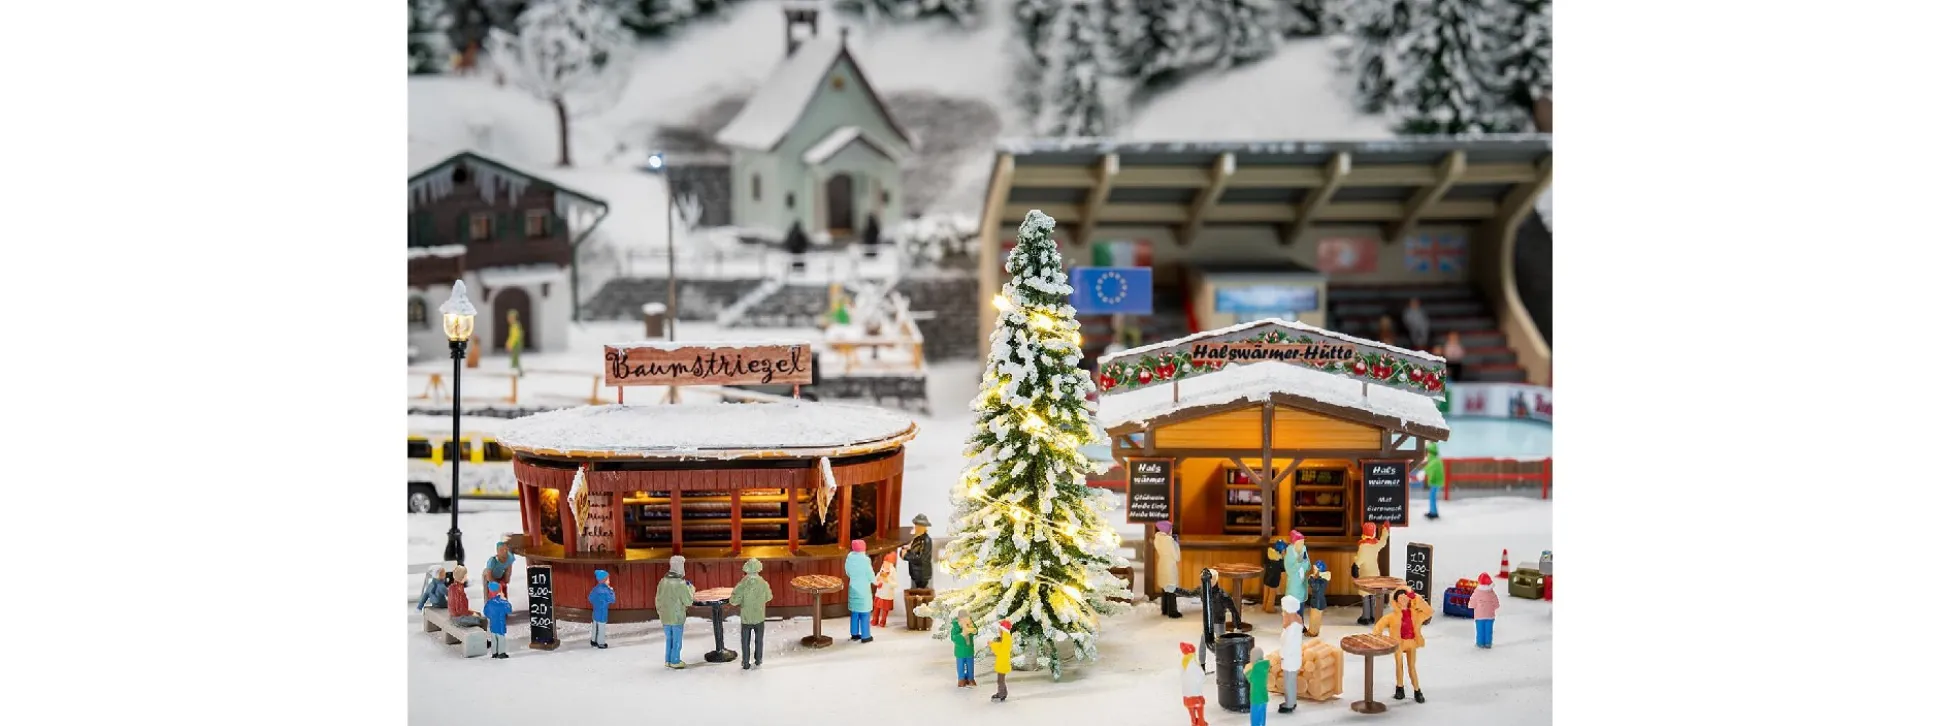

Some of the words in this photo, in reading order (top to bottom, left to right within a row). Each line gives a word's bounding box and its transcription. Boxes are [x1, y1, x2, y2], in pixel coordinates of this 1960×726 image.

[1193, 344, 1353, 361] Halswärmer-Hütte
[605, 349, 805, 384] Baumstriezel
[1138, 463, 1161, 472] Hals
[1373, 466, 1396, 475] Hals
